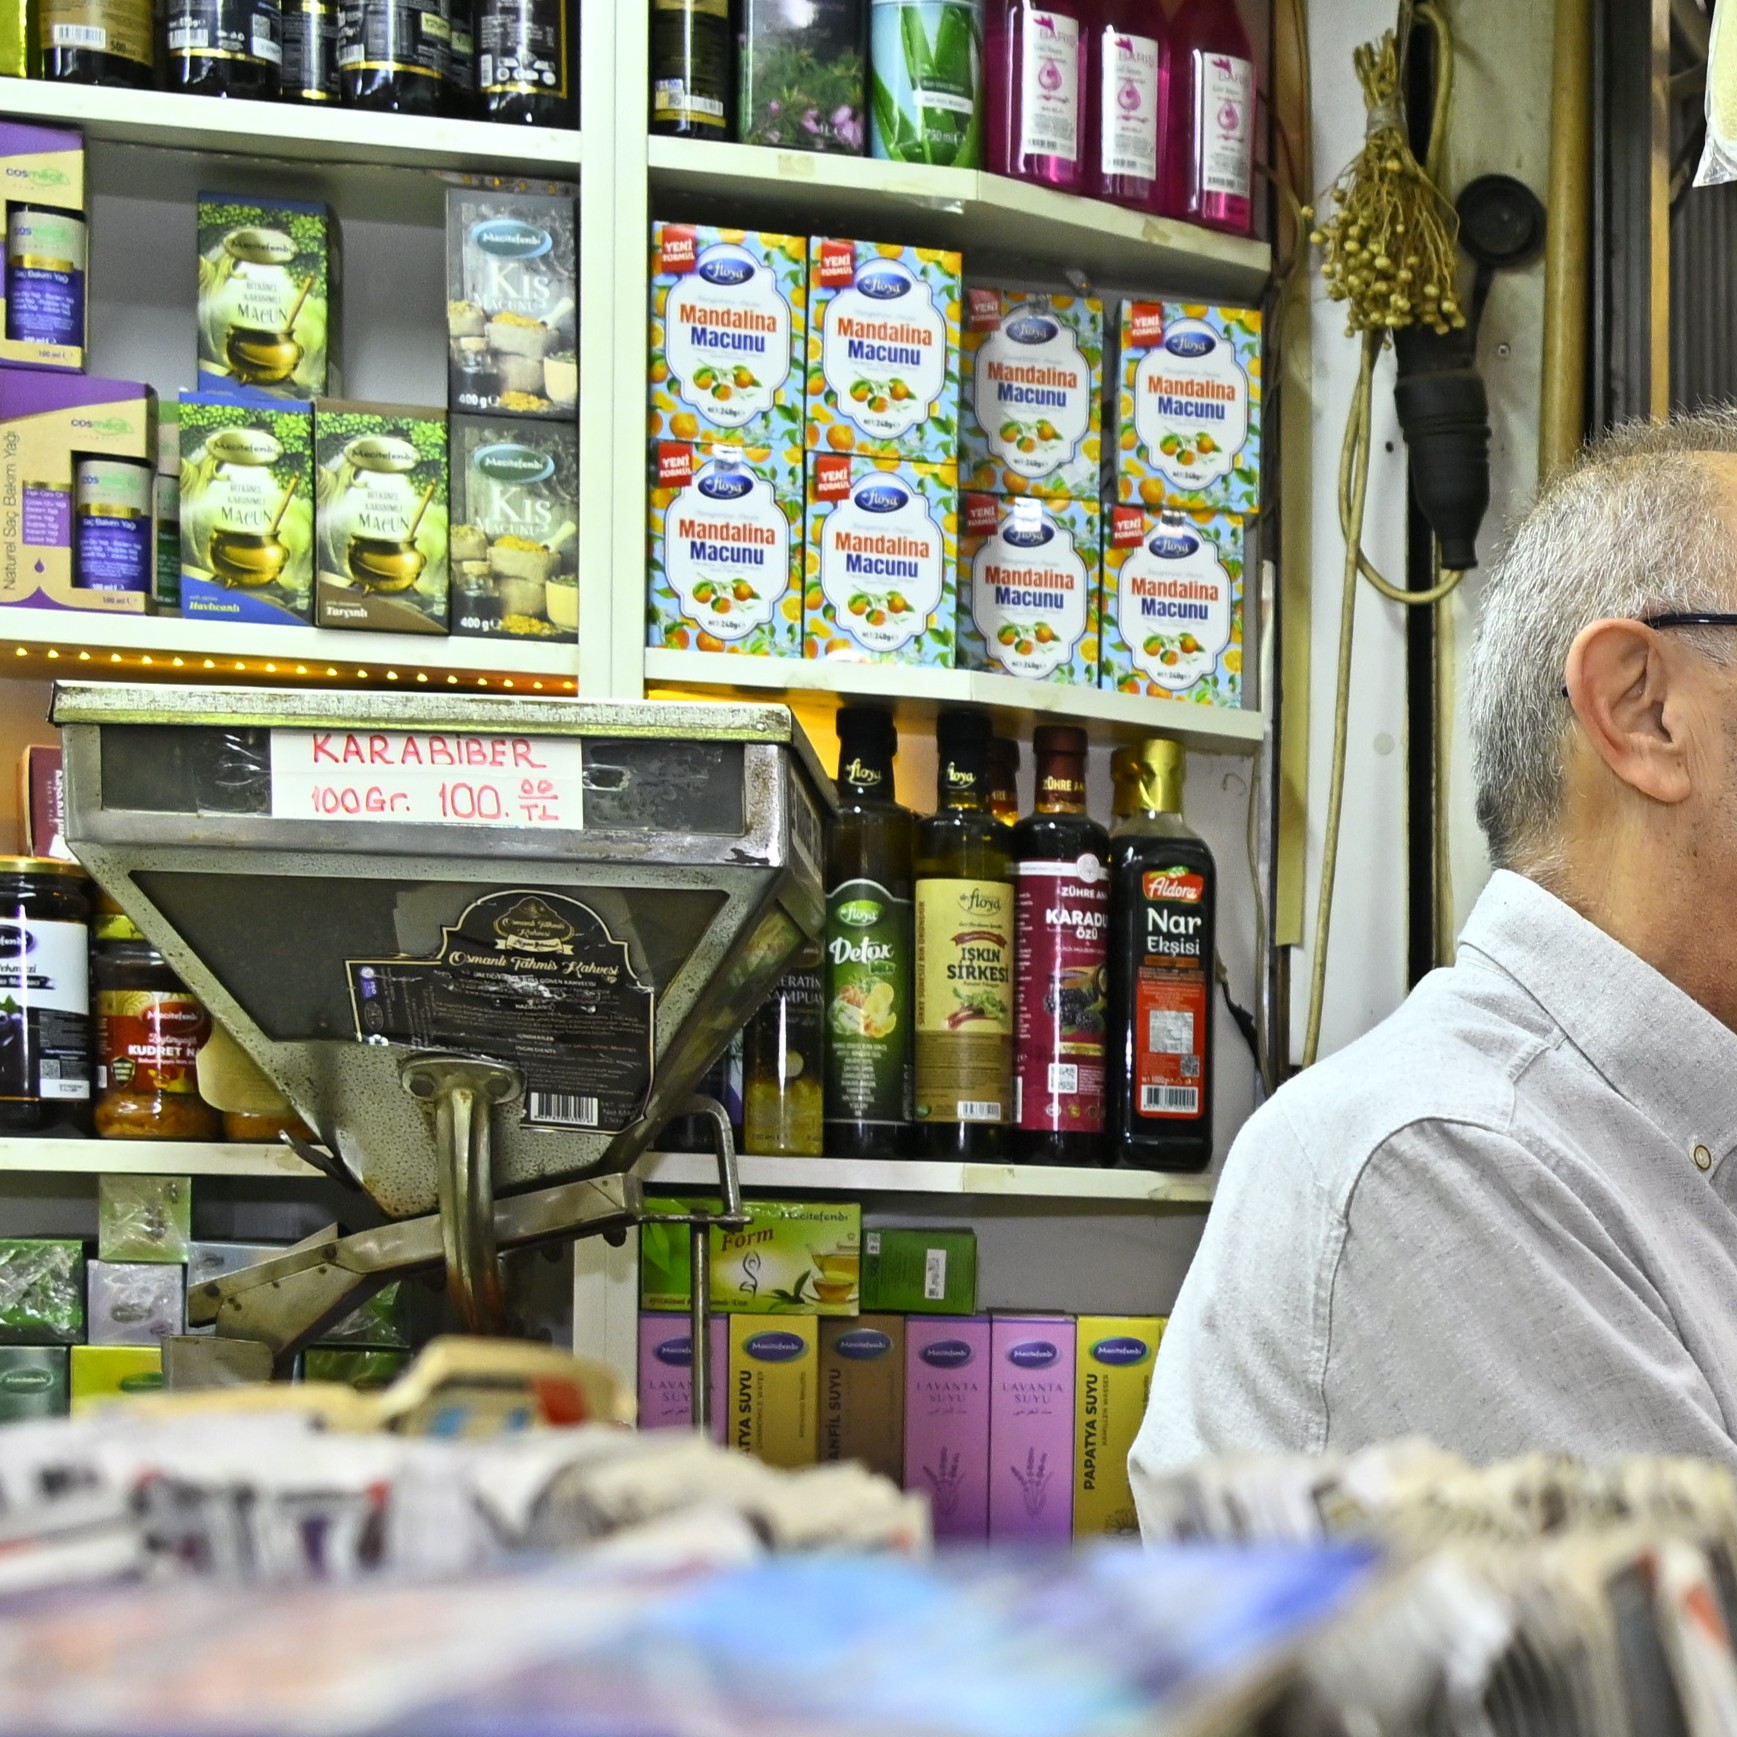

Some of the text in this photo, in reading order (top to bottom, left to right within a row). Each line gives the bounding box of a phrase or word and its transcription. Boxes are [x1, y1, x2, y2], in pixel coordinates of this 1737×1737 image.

[664, 238, 694, 253] YENİ
[823, 253, 852, 267] YENİ
[679, 303, 778, 333] Mandalina
[1133, 313, 1160, 328] YENİ
[690, 325, 766, 352] Macunu
[837, 316, 934, 346] Mandalina
[847, 339, 921, 366] Macunu
[987, 361, 1078, 389] Mandalina
[997, 382, 1067, 407] Macunu
[1147, 374, 1236, 402] Mandalina
[1157, 395, 1226, 420] Macunu
[661, 453, 690, 468] YENİ
[3, 463, 17, 506] Bakım
[820, 467, 849, 482] YENİ
[969, 505, 996, 519] YENİ
[1116, 517, 1141, 531] YENİ
[678, 518, 776, 546] Mandalina
[835, 530, 931, 559] Mandalina
[3, 541, 17, 590] Naturel
[689, 540, 765, 566] Macunu
[845, 552, 919, 579] Macunu
[984, 565, 1075, 590] Mandalina
[1130, 576, 1220, 602] Mandalina
[994, 585, 1065, 610] Macunu
[1140, 597, 1210, 621] Macunu
[311, 732, 548, 770] KARABİBER
[311, 785, 411, 814] 100Gr.
[519, 804, 560, 822] TL
[1061, 885, 1095, 899] ZÜHRE
[1149, 877, 1199, 900] Aldora
[1146, 907, 1203, 935] Nar
[829, 935, 894, 966] Detox
[960, 947, 1001, 966] IŞKIN
[1146, 935, 1201, 957] Ekşisi
[448, 951, 620, 978] Osmanlı Tahmis Kahvesi
[946, 961, 1010, 984] SİRKESİ
[127, 1044, 183, 1057] KUDRET
[720, 1227, 775, 1252] Form
[649, 1380, 715, 1391] LAVANA
[662, 1391, 691, 1402] SUY
[739, 1370, 752, 1413] SUYU
[828, 1369, 841, 1410] SUYU
[916, 1381, 978, 1392] LAVANTA
[1002, 1382, 1064, 1393] LAVANTA
[1084, 1373, 1098, 1491] PAPATYA SUYU
